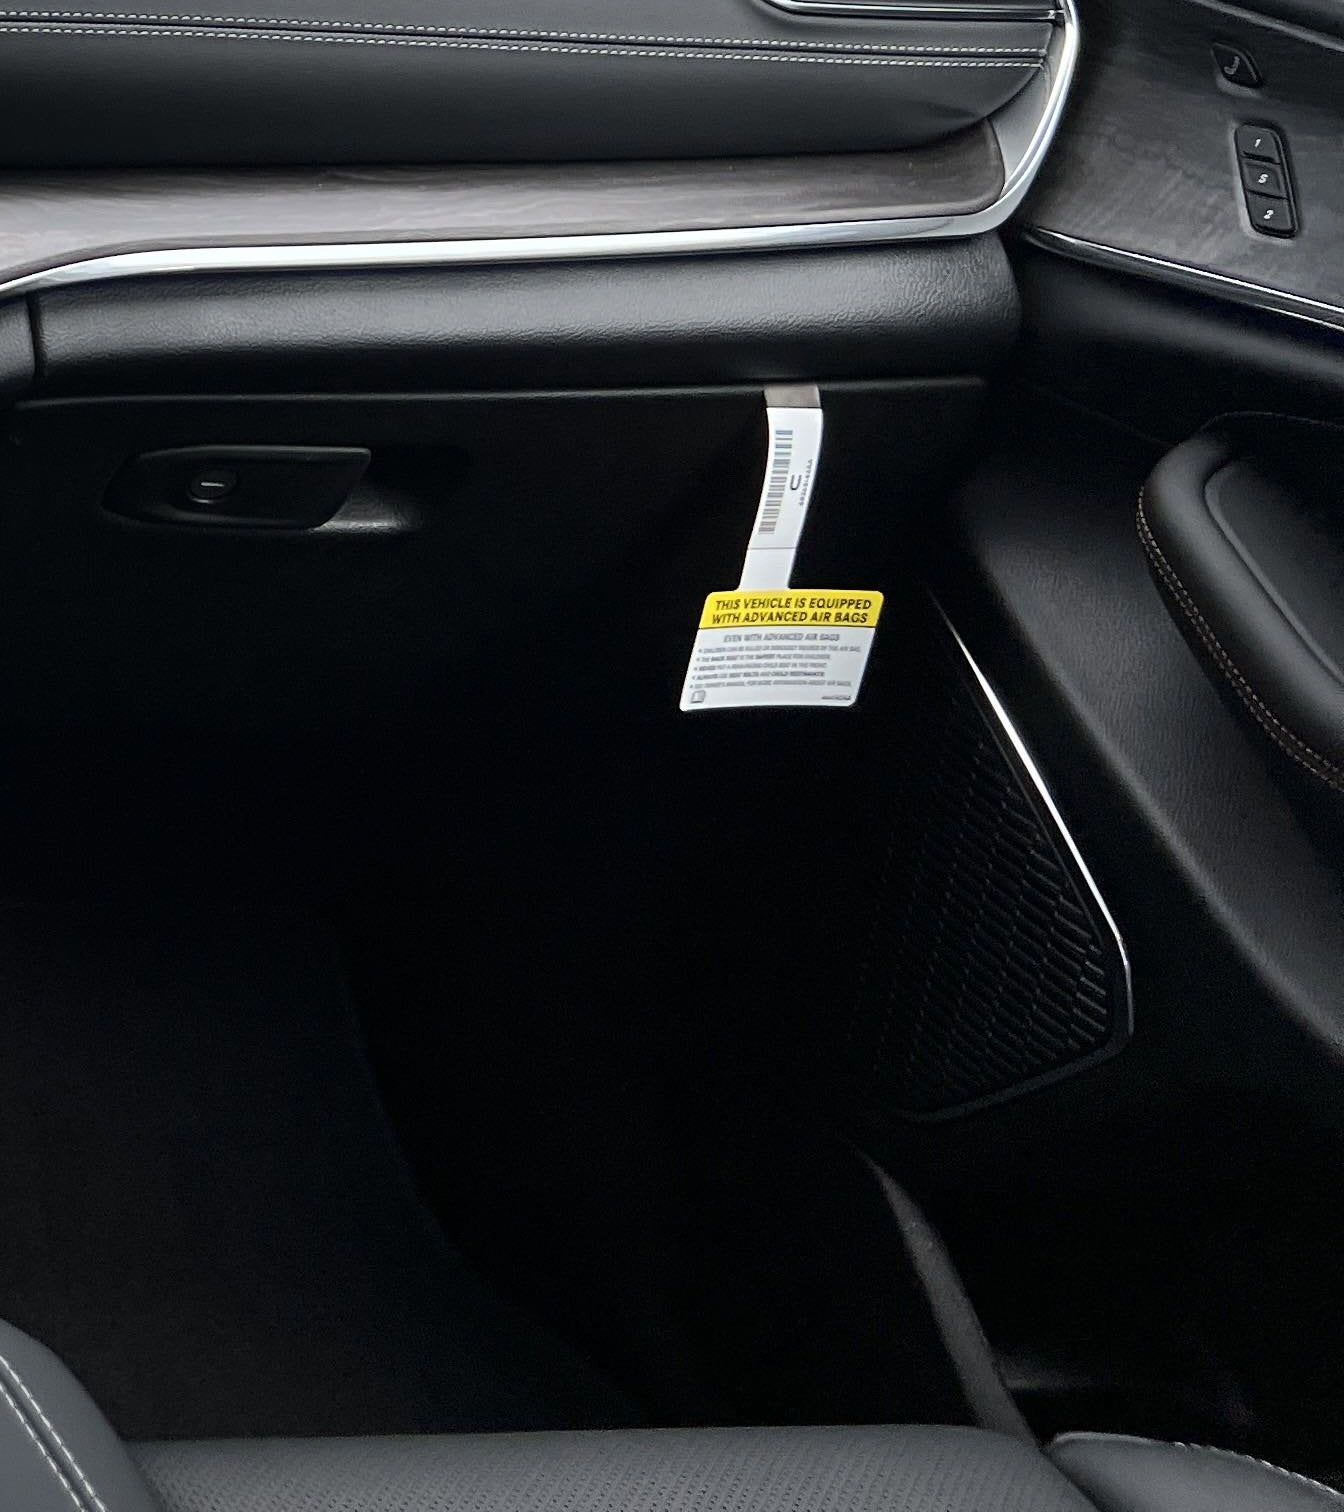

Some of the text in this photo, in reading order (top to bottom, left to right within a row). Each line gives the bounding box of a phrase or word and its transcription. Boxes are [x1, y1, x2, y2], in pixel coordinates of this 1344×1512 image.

[1254, 138, 1261, 148] 1
[1263, 209, 1274, 220] 2
[716, 597, 872, 611] THIS VEHICLE IS EQUIPPED
[712, 611, 868, 624] WITH ADVANCED AIR BAGS
